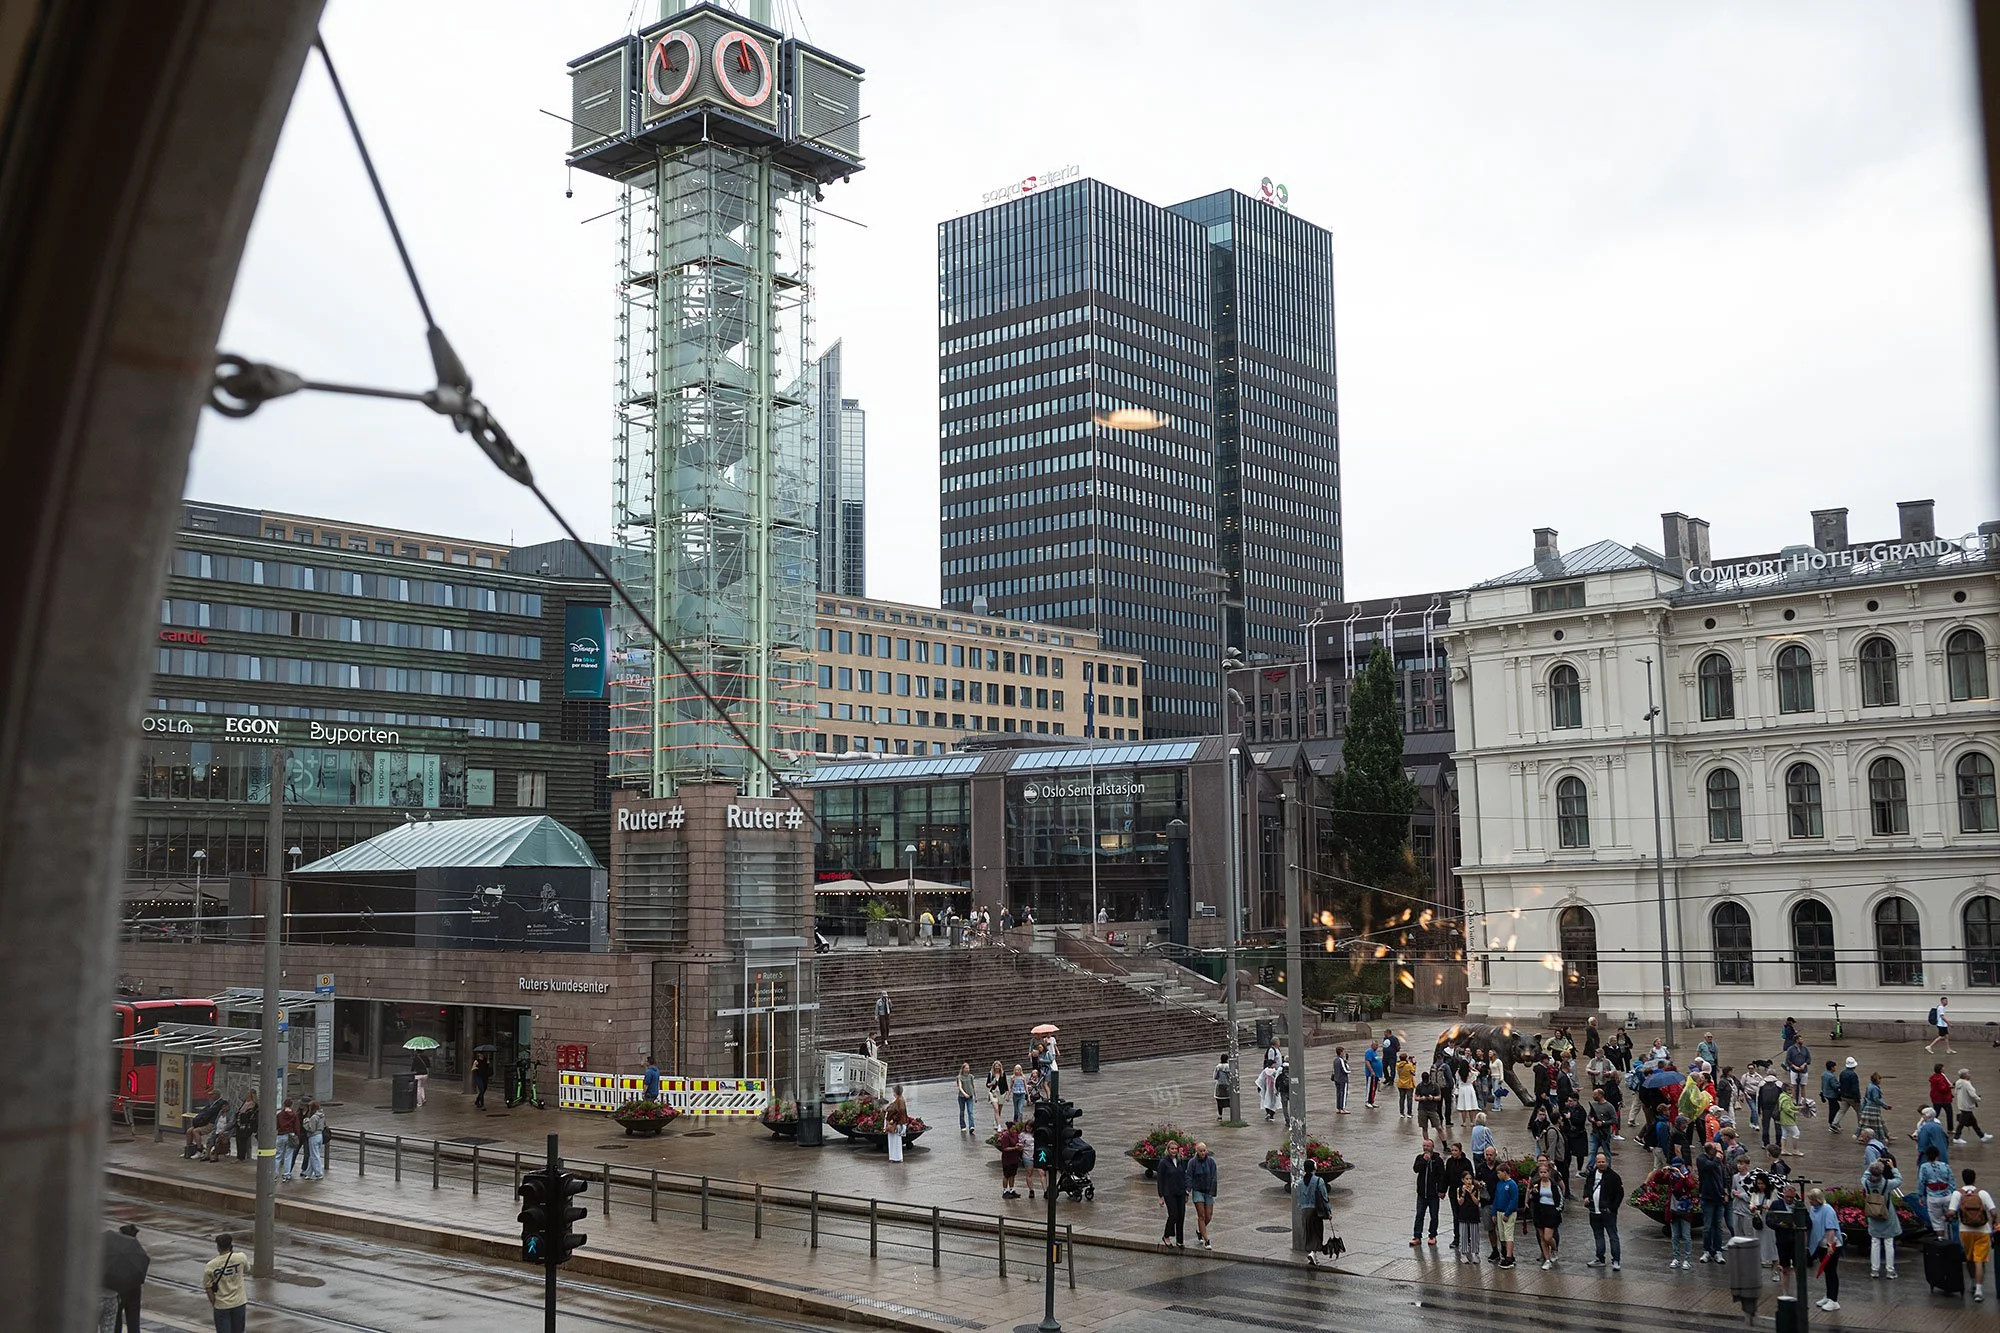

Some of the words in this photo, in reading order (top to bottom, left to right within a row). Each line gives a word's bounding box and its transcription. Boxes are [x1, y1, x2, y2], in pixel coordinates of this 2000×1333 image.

[1039, 164, 1080, 186] steria
[1685, 558, 1786, 585] COMFORT
[1793, 551, 1862, 572] HOTEL
[1870, 540, 1953, 563] GRAND
[159, 629, 209, 645] candic
[225, 717, 280, 735] EGON
[310, 721, 400, 745] Byporten
[224, 736, 280, 744] RESTAURANT
[1042, 785, 1066, 798] Oslo
[1067, 780, 1146, 798] Sentralstasjon
[617, 804, 685, 831] Ruter#
[727, 804, 804, 830] Ruter#
[519, 977, 549, 991] Ruters
[550, 978, 609, 993] kundesenter
